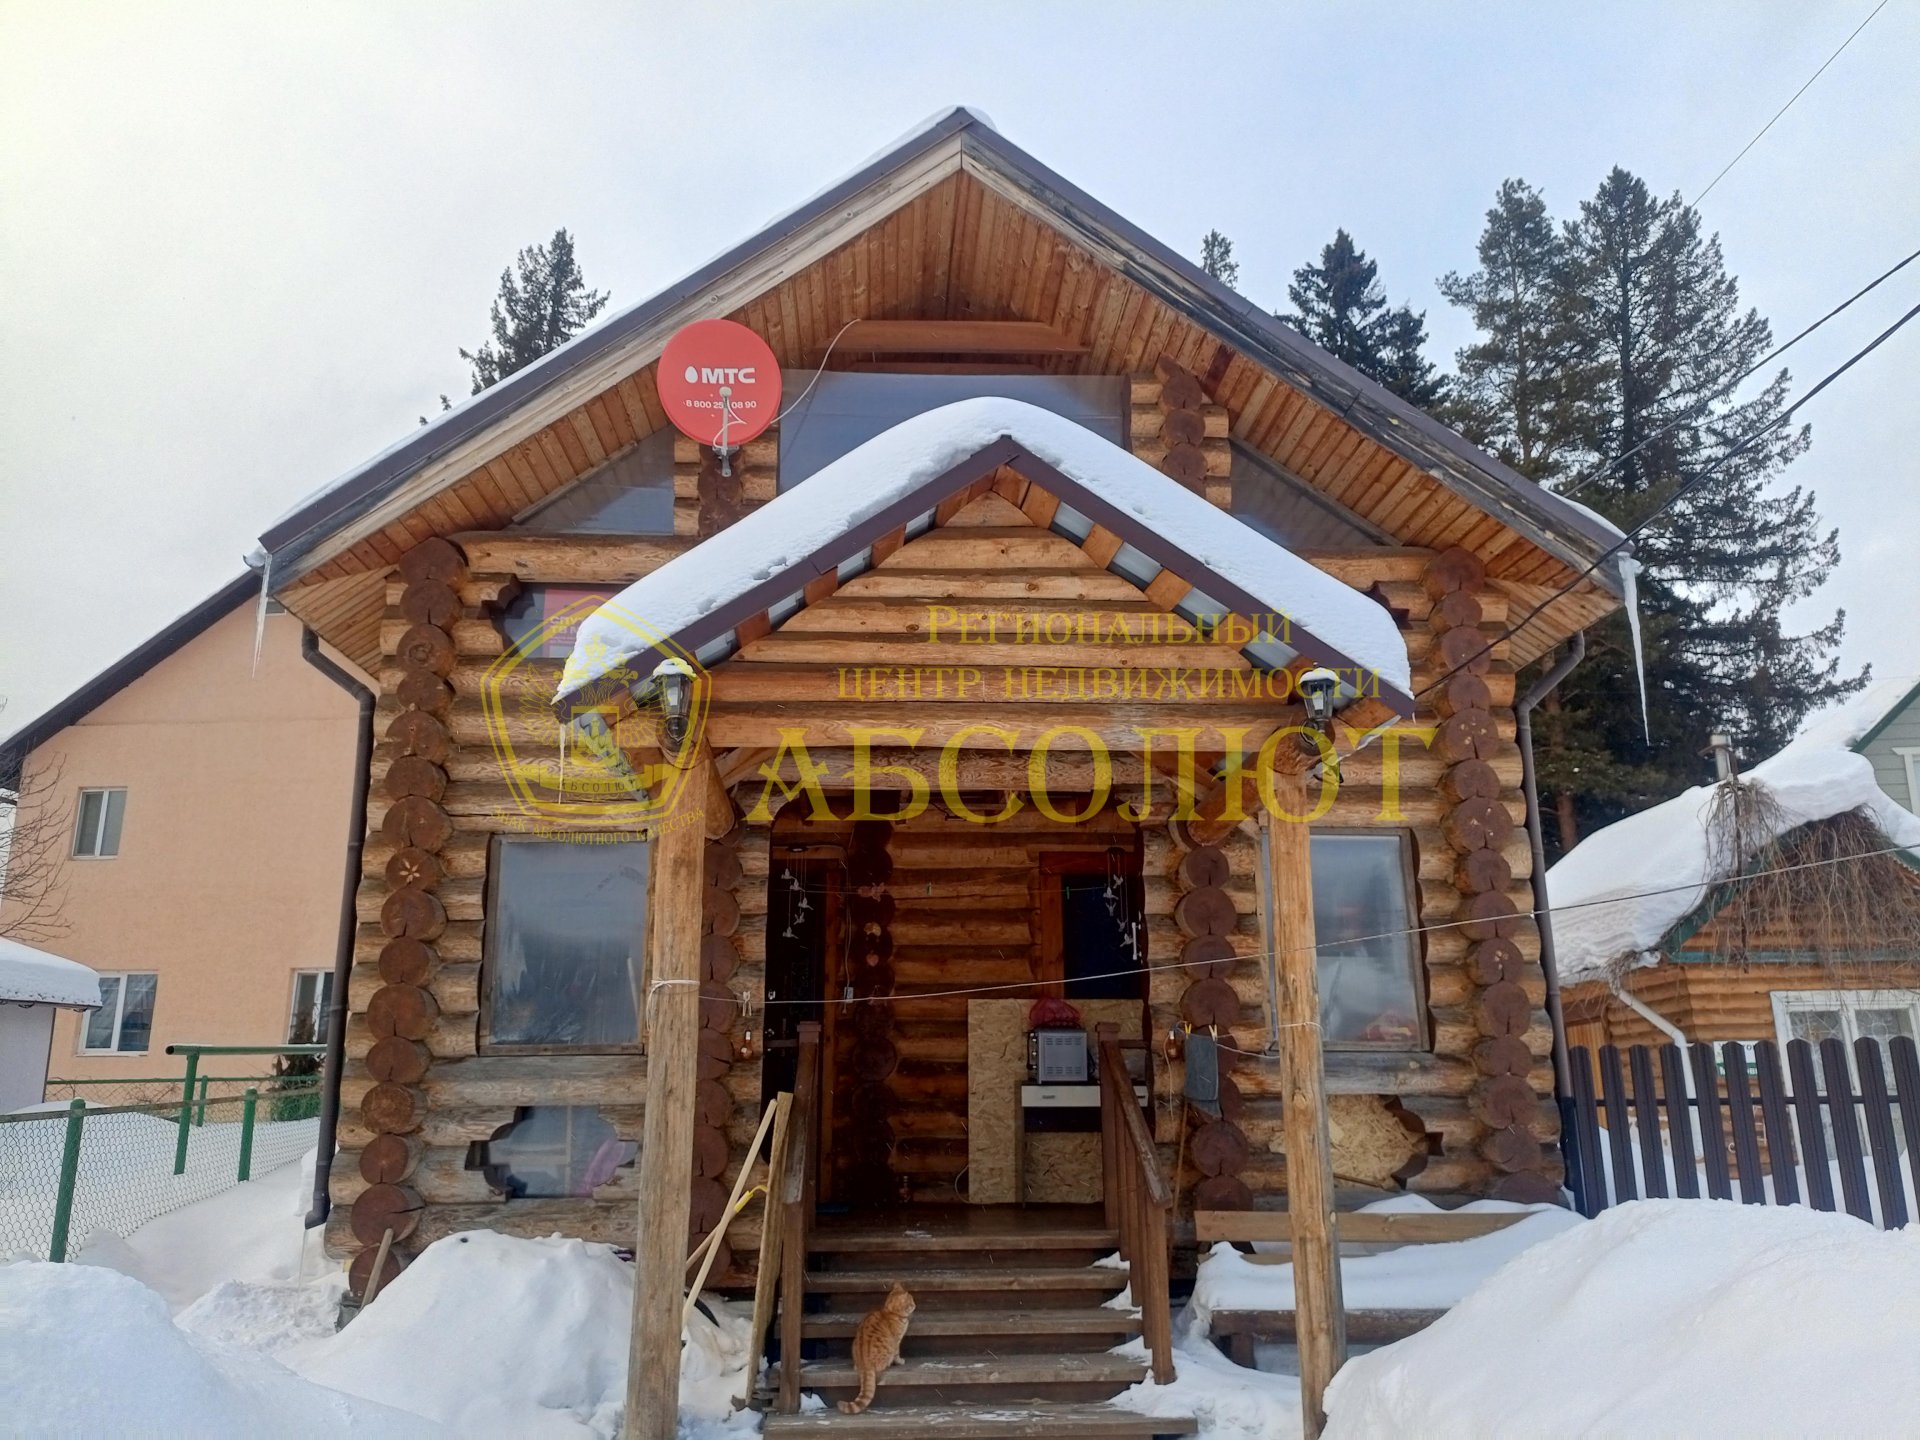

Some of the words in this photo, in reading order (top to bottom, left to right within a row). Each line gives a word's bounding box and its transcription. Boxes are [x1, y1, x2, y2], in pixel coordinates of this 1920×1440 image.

[701, 367, 756, 384] МТС
[686, 399, 692, 407] 8
[745, 400, 757, 408] 90
